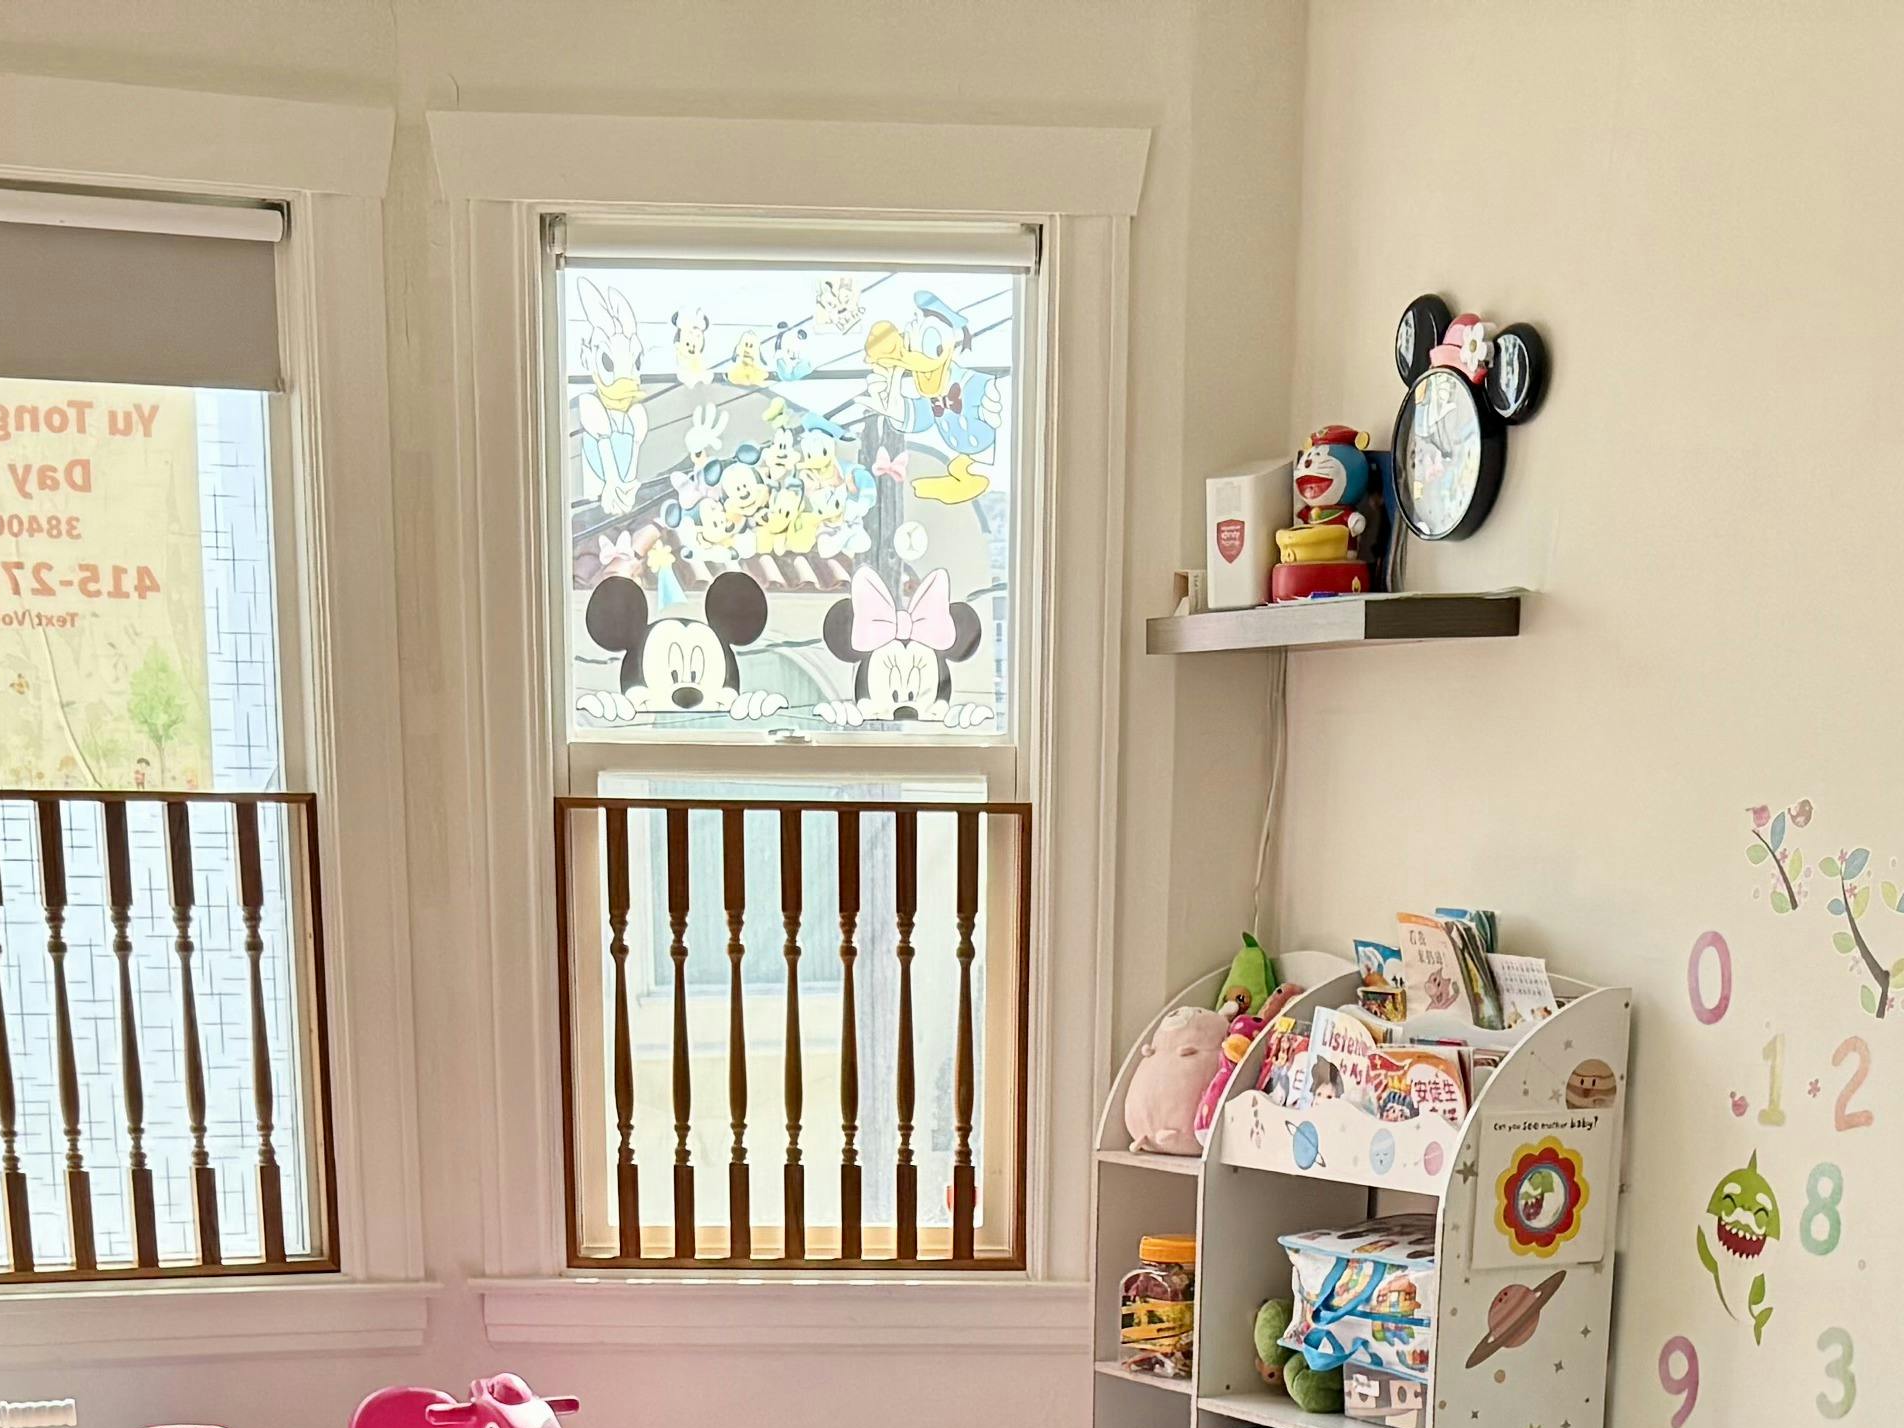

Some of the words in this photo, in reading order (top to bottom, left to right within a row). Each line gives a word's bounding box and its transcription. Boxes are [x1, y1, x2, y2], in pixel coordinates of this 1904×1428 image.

[1414, 1079, 1457, 1103] 安徒生
[1758, 1033, 1786, 1126] 1
[1831, 1035, 1875, 1132] 2
[1799, 1162, 1844, 1256] 8
[1815, 1326, 1856, 1420] 3
